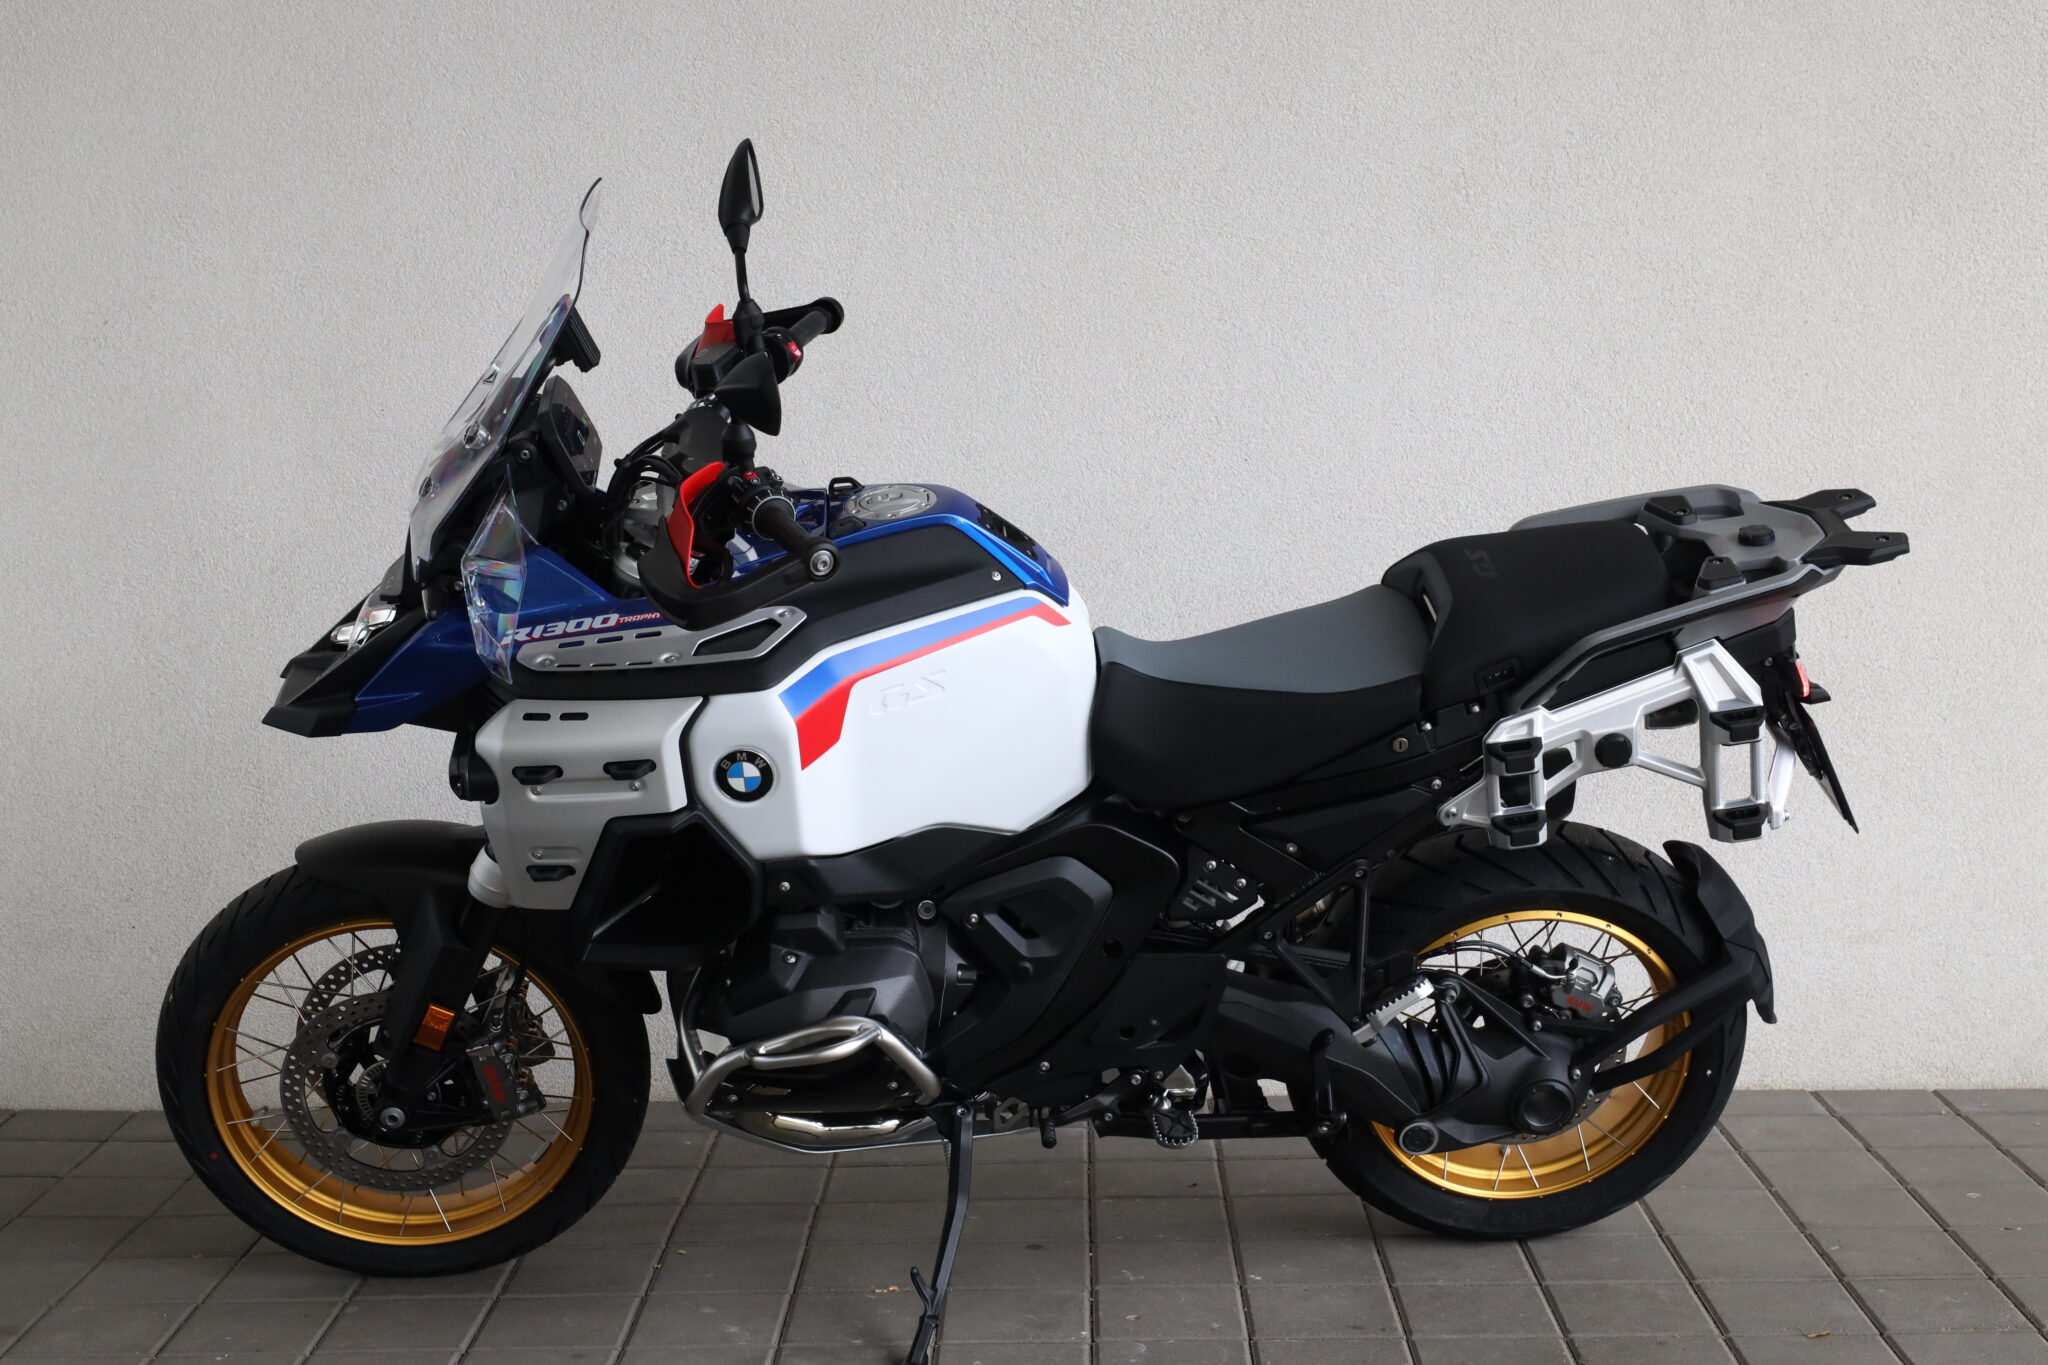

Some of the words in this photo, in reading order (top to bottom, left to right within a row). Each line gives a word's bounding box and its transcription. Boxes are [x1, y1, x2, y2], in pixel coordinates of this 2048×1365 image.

[501, 613, 620, 645] R1300
[619, 612, 660, 623] TROPHY
[720, 752, 767, 770] BMW
